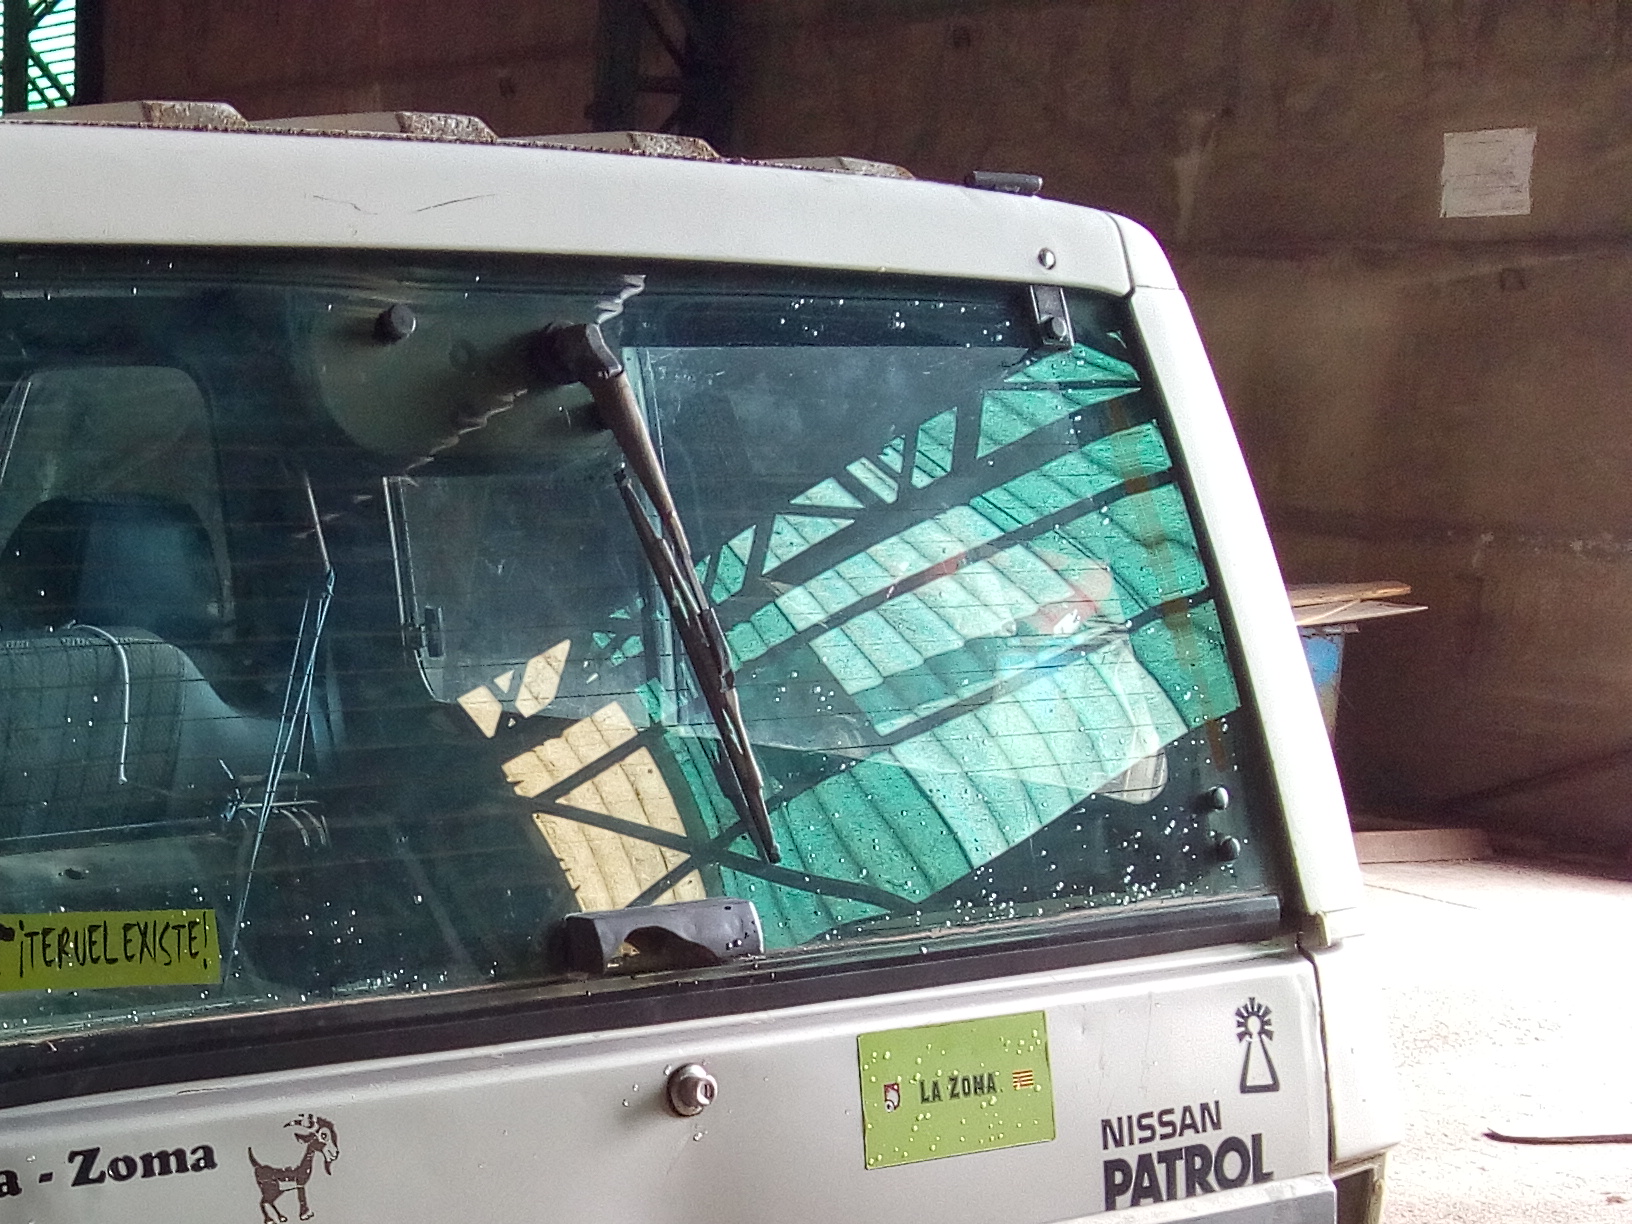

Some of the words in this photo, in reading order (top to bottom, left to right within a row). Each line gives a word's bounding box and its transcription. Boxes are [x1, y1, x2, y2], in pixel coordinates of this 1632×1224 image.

[122, 911, 208, 970] EXISTE!
[919, 1079, 943, 1104] LA
[1101, 1100, 1223, 1150] NISSAN
[69, 1145, 219, 1188] Zoma
[1103, 1133, 1274, 1212] PATROL
